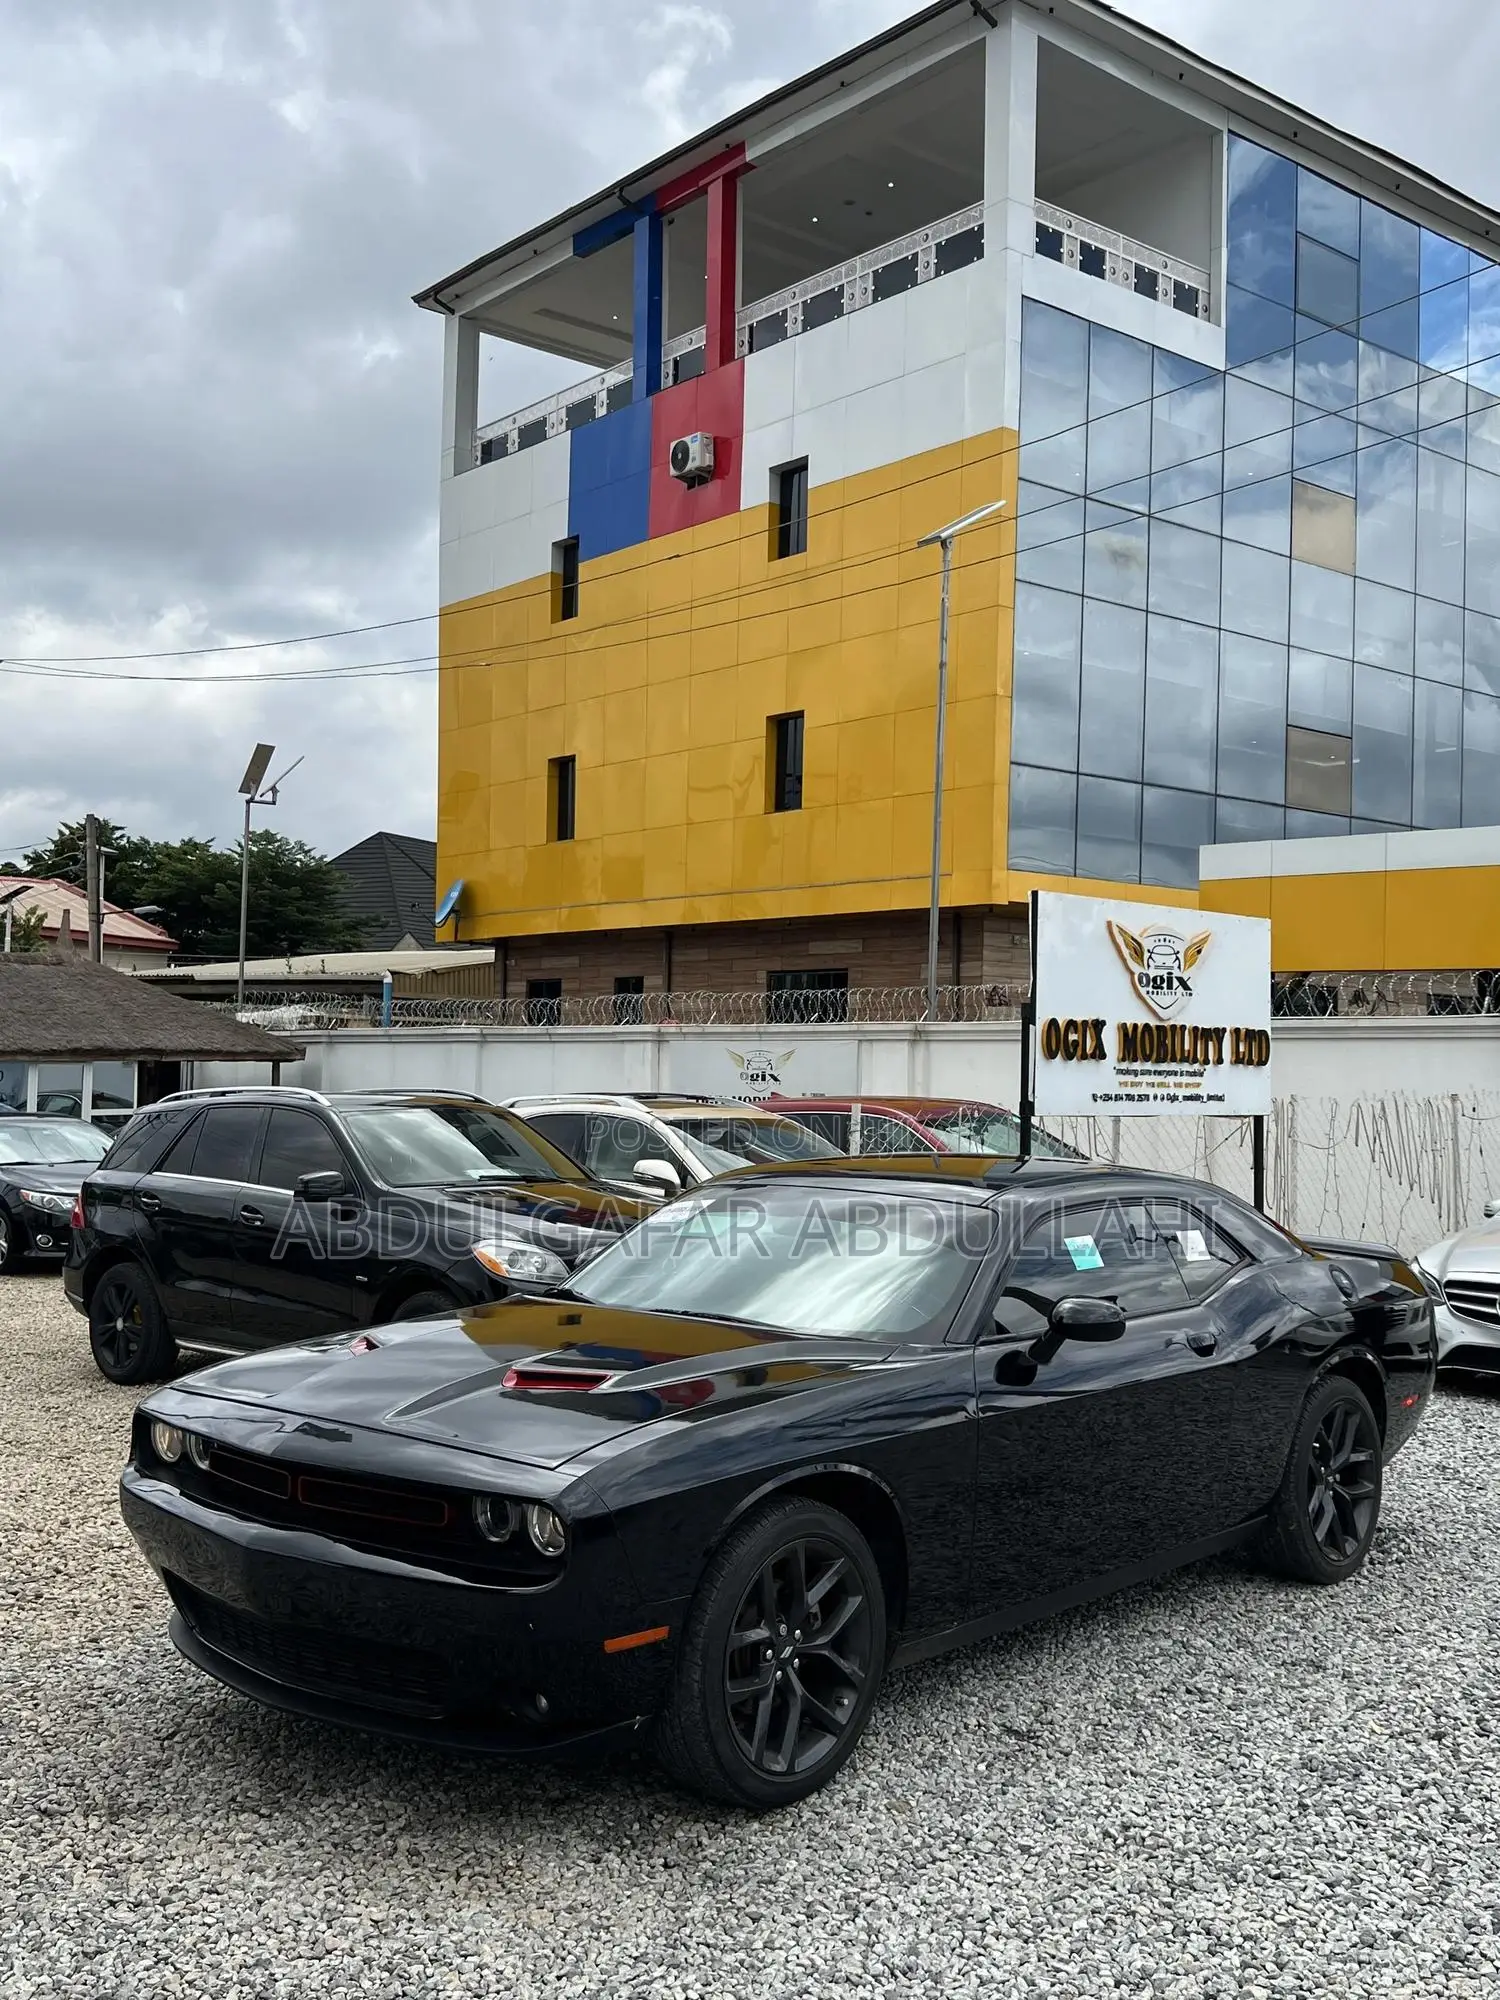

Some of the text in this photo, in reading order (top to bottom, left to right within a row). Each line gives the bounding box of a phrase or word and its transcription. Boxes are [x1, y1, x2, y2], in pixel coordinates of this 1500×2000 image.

[1138, 971, 1193, 991] Ogix
[1041, 1017, 1271, 1067] OGIX MOBILITY LTD
[740, 1071, 782, 1084] Ogix
